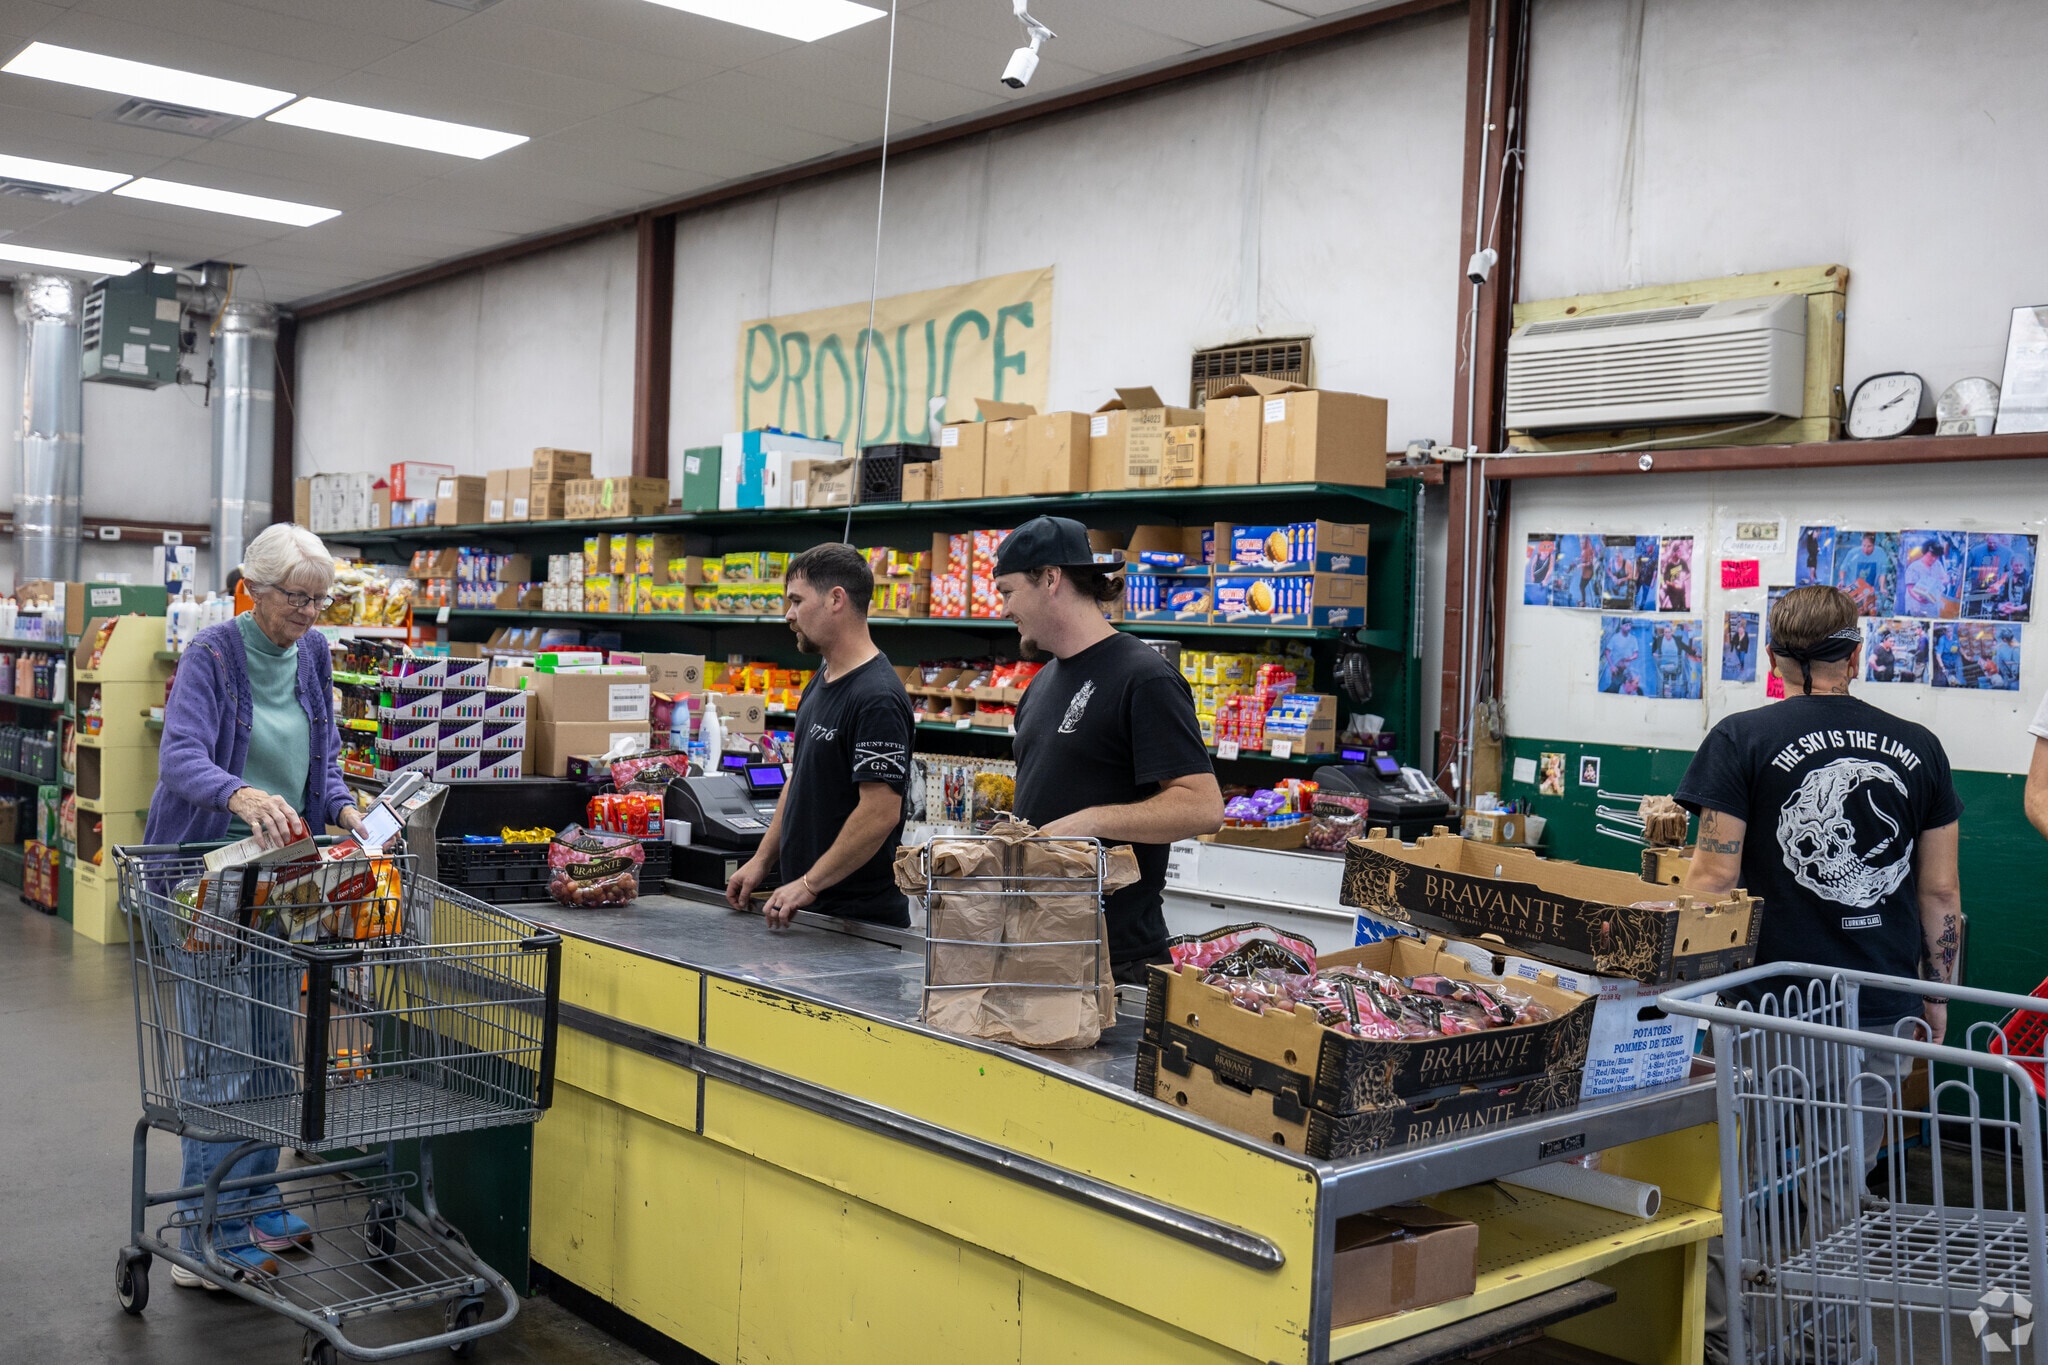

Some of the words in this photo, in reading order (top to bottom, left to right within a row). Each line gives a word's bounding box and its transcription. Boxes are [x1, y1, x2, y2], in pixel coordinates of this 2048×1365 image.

[743, 300, 1035, 449] PRODUCE
[1722, 577, 1756, 588] SHAME
[810, 723, 838, 741] 1776
[884, 742, 905, 750] STYLE
[1771, 743, 1806, 773] THE
[1799, 731, 1828, 754] SKY
[1827, 729, 1845, 748] IS
[1846, 730, 1878, 750] THE
[1880, 735, 1922, 772] LIMIT
[870, 761, 888, 771] GS
[573, 859, 622, 876] BRAVANTE
[1424, 874, 1565, 927] BRAVANTE
[1426, 897, 1560, 938] VINEYARDS
[1844, 917, 1867, 927] LURKING
[1867, 915, 1880, 925] CLASS
[1633, 1024, 1673, 1039] POTATOES
[1419, 1032, 1535, 1073] BRAVANTE
[1613, 1039, 1648, 1054] POMMES
[1648, 1038, 1662, 1050] DE
[1661, 1035, 1684, 1048] TERRE
[1214, 1054, 1253, 1077] BRAVANTE
[1420, 1055, 1526, 1083] VINEYARDS
[1596, 1056, 1635, 1068] White/Blanc
[1594, 1066, 1629, 1077] Red/Rouge
[1592, 1083, 1638, 1095] Russet/Rousse
[1593, 1075, 1635, 1086] Yellow/Jaune
[1407, 1102, 1516, 1143] BRAVANTE
